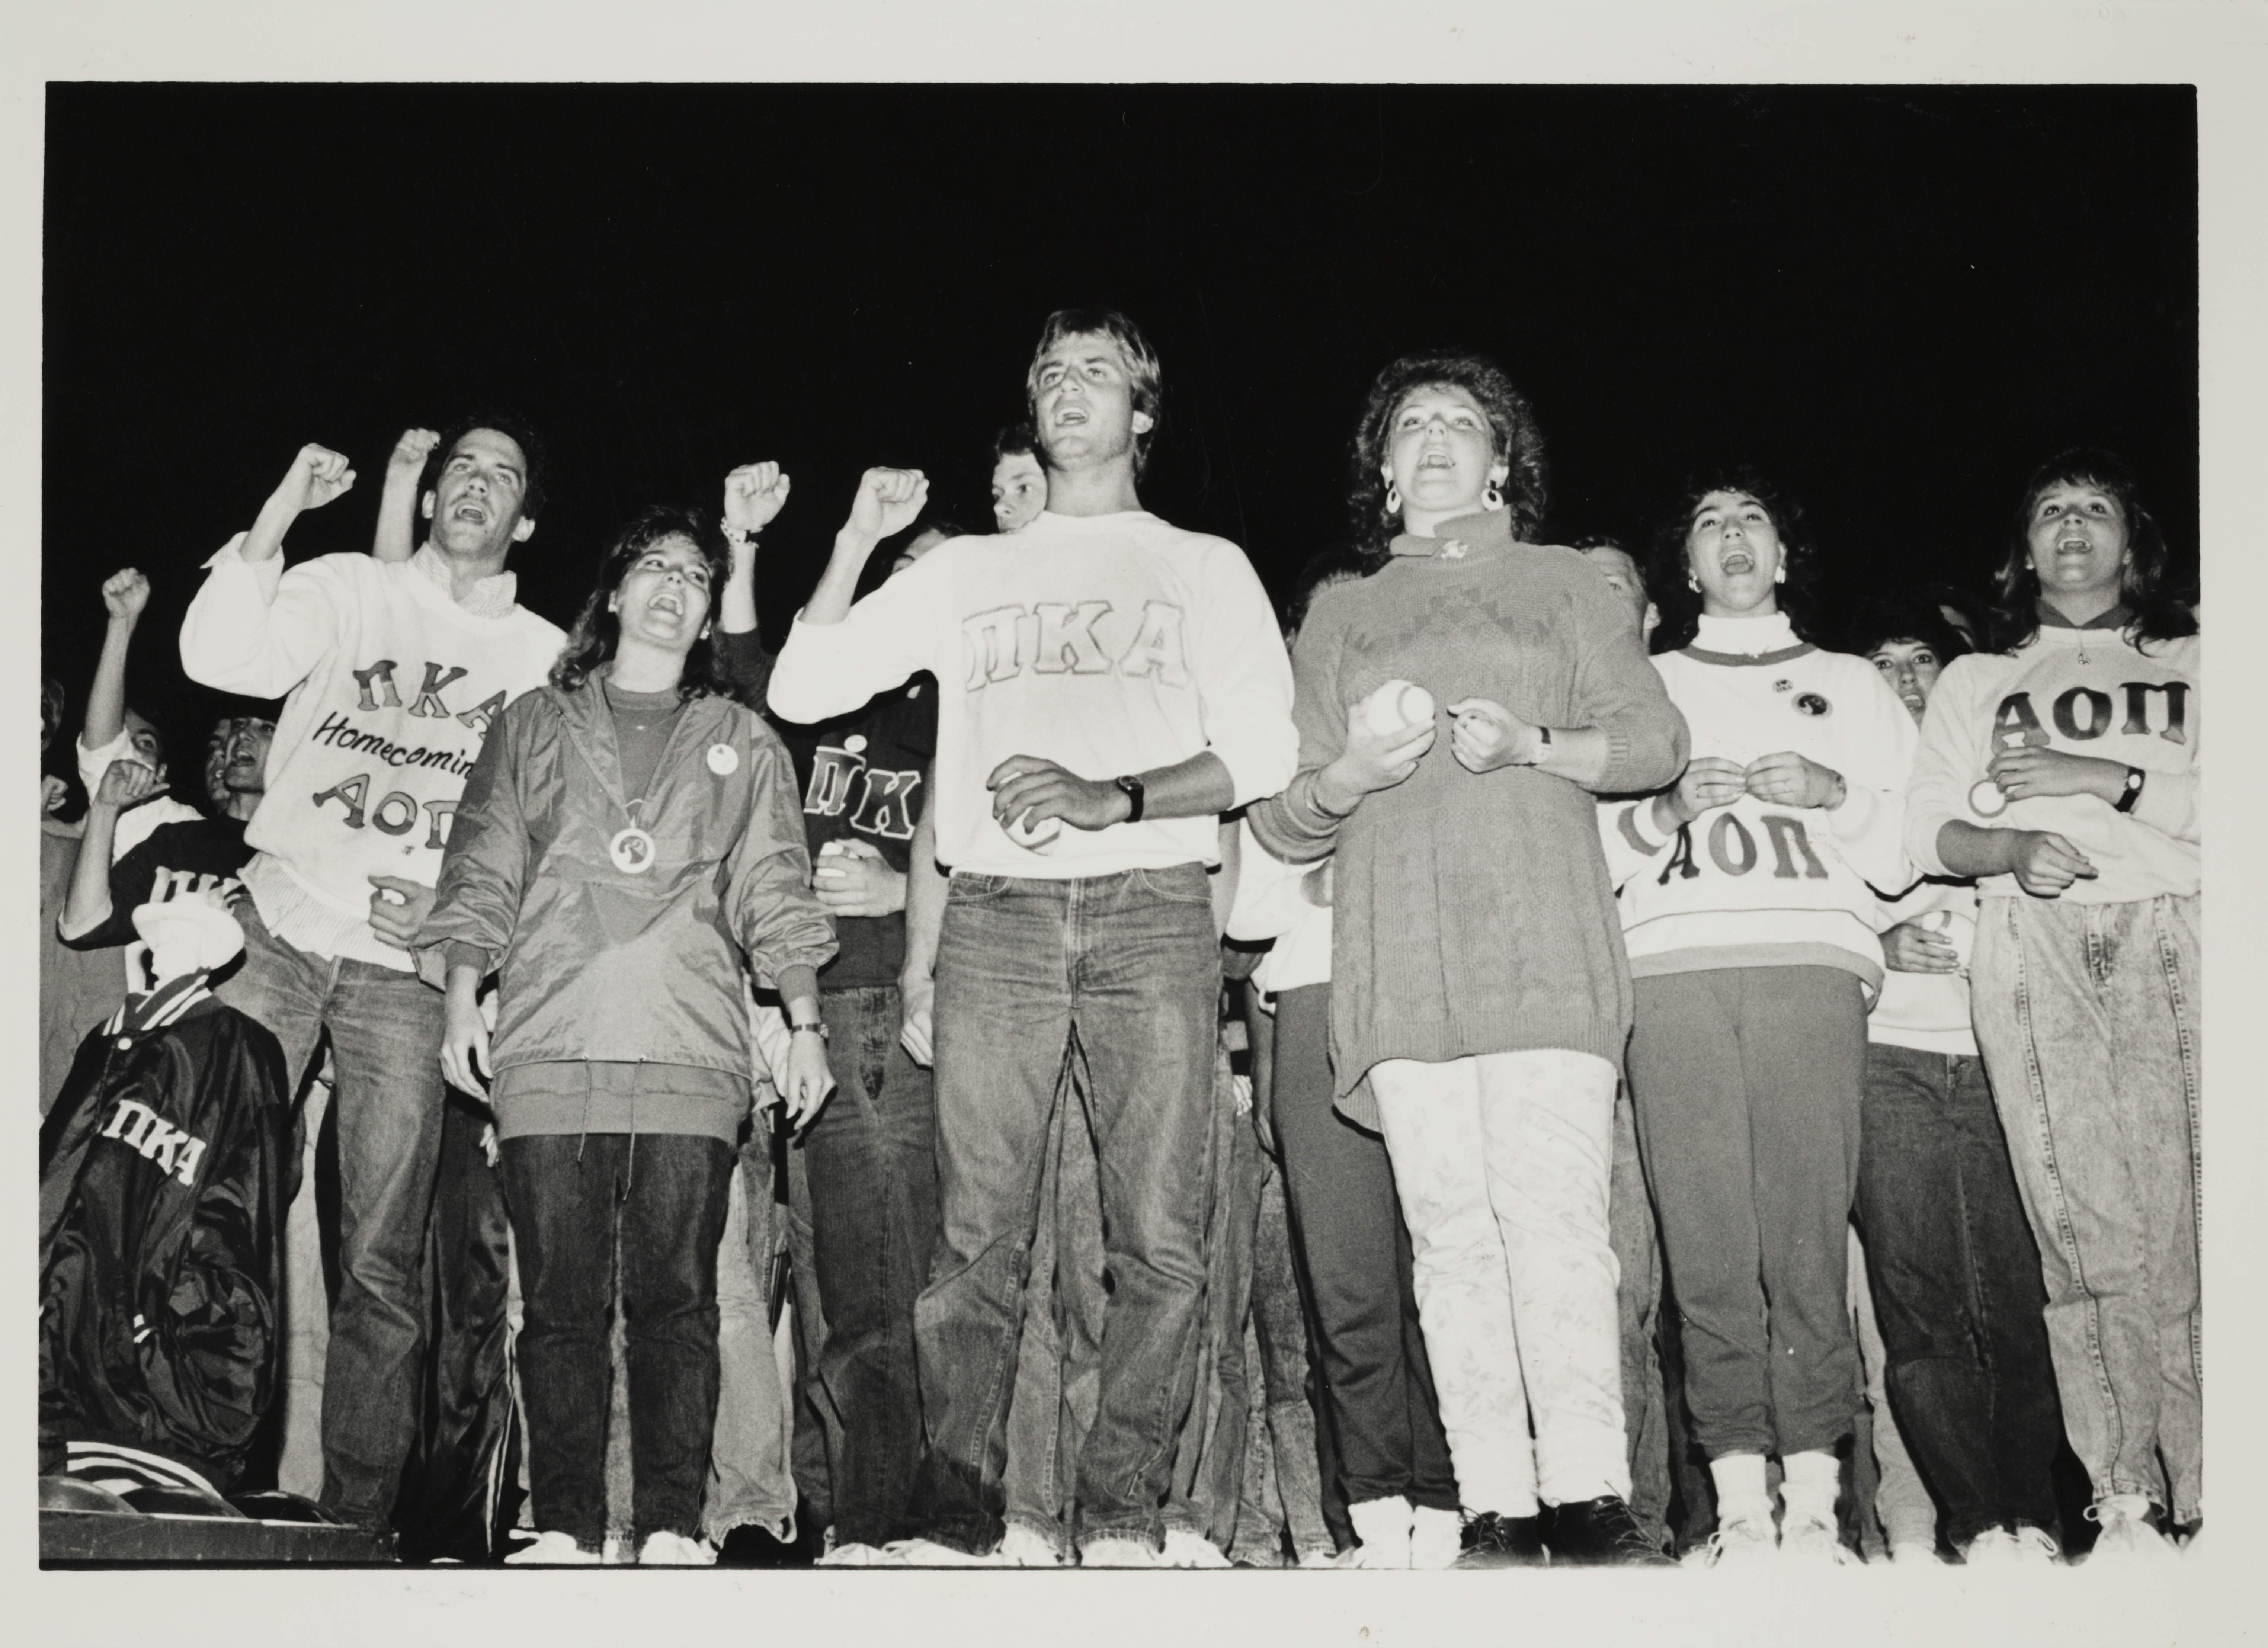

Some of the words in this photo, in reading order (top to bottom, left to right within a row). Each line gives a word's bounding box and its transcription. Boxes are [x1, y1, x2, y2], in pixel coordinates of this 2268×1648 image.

[962, 599, 1191, 692] ΠΚΑ
[353, 659, 507, 741] ΠΚΑ
[1991, 681, 2191, 757] ΑΟΠ
[312, 711, 475, 779] Homecomin
[803, 745, 922, 840] ΠΚ
[1657, 812, 1829, 886] ΑΟΠ
[102, 1099, 206, 1186] ΠΚΑ
